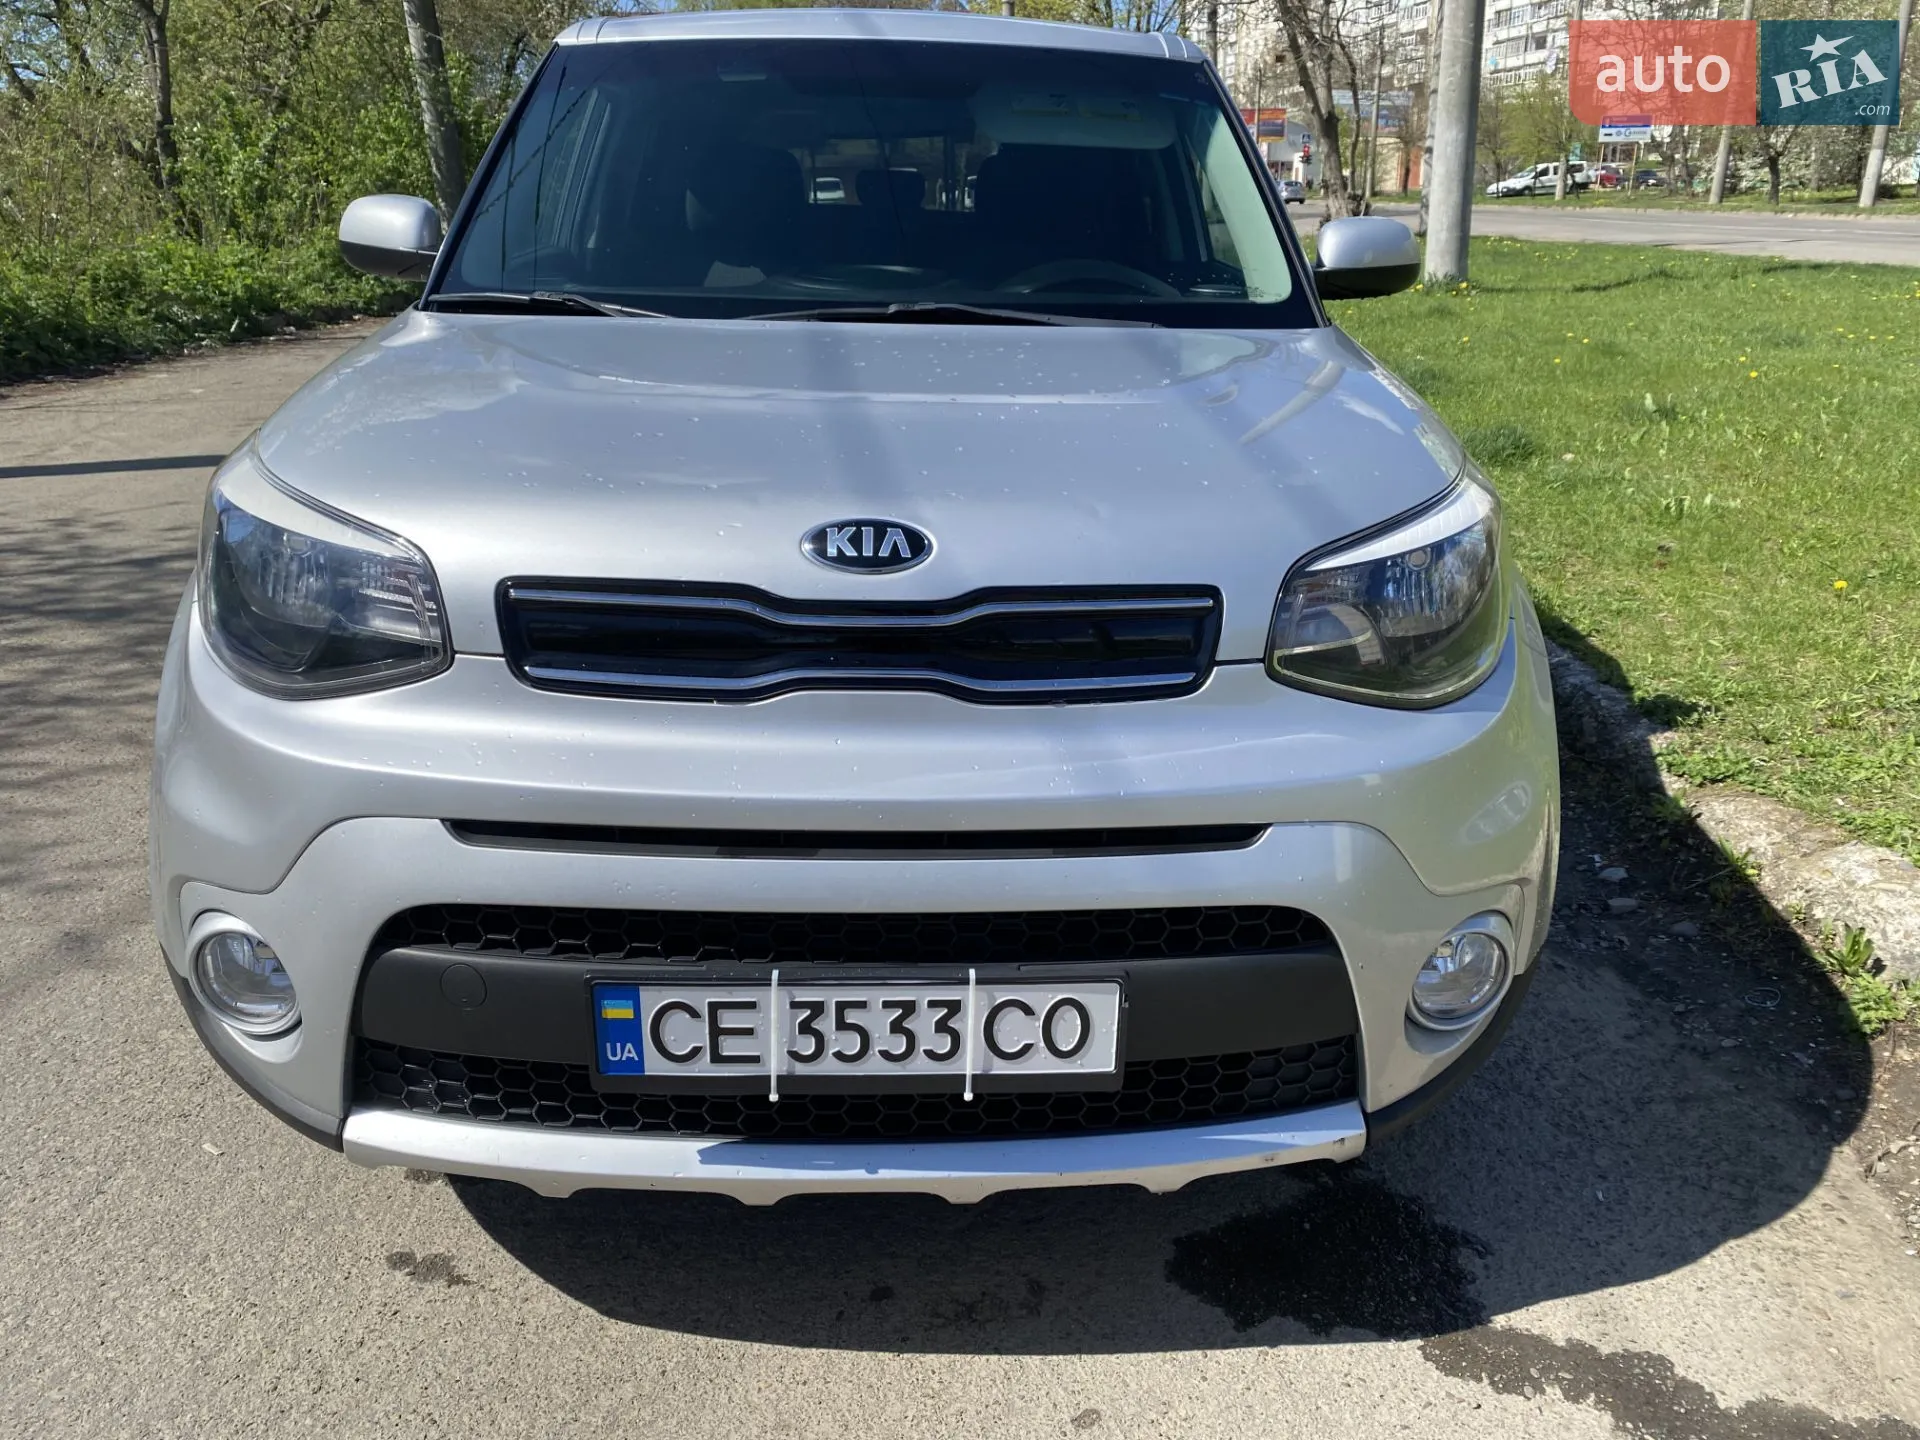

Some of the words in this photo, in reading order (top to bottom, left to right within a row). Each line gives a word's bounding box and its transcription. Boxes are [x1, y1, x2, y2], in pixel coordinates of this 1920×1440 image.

[825, 526, 912, 558] KIA
[648, 998, 761, 1064] CE
[785, 998, 963, 1064] 3533
[983, 996, 1091, 1062] CO
[605, 1042, 639, 1061] UA
